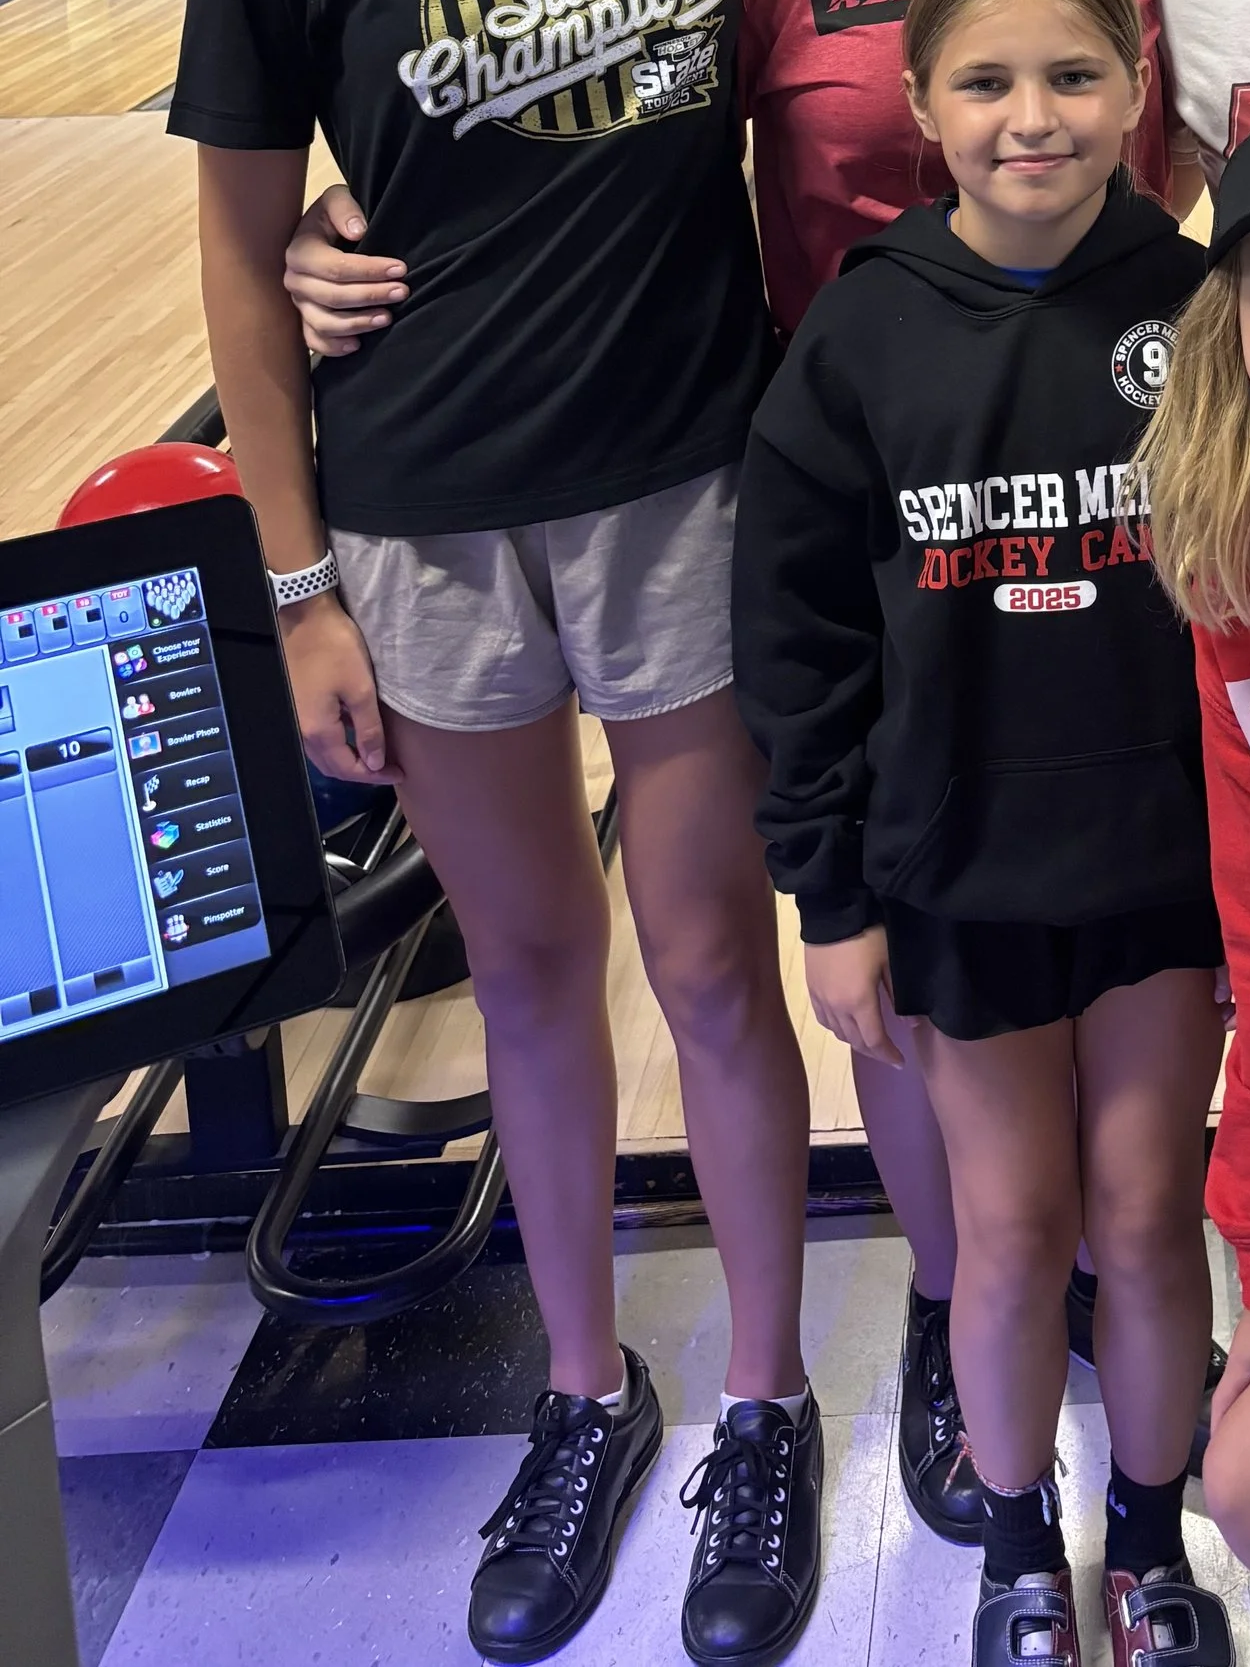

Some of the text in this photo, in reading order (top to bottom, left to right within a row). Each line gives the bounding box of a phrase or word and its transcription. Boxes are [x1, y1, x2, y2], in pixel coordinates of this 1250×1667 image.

[631, 43, 716, 99] State
[1115, 323, 1160, 363] SPENCER
[1142, 340, 1170, 388] 9
[1118, 375, 1161, 405] HOCKEY
[899, 472, 1069, 542] SPENCER
[1009, 585, 1082, 611] 2025
[118, 609, 130, 624] 0
[153, 637, 201, 656] Choose Your
[156, 646, 200, 664] Experience
[169, 685, 202, 701] Bowlers
[167, 726, 220, 747] Bowler Photo
[59, 740, 81, 759] 10
[184, 775, 211, 788] Recap
[194, 815, 233, 832] Statistics
[205, 863, 230, 876] Score
[203, 905, 246, 925] Pinspotter
